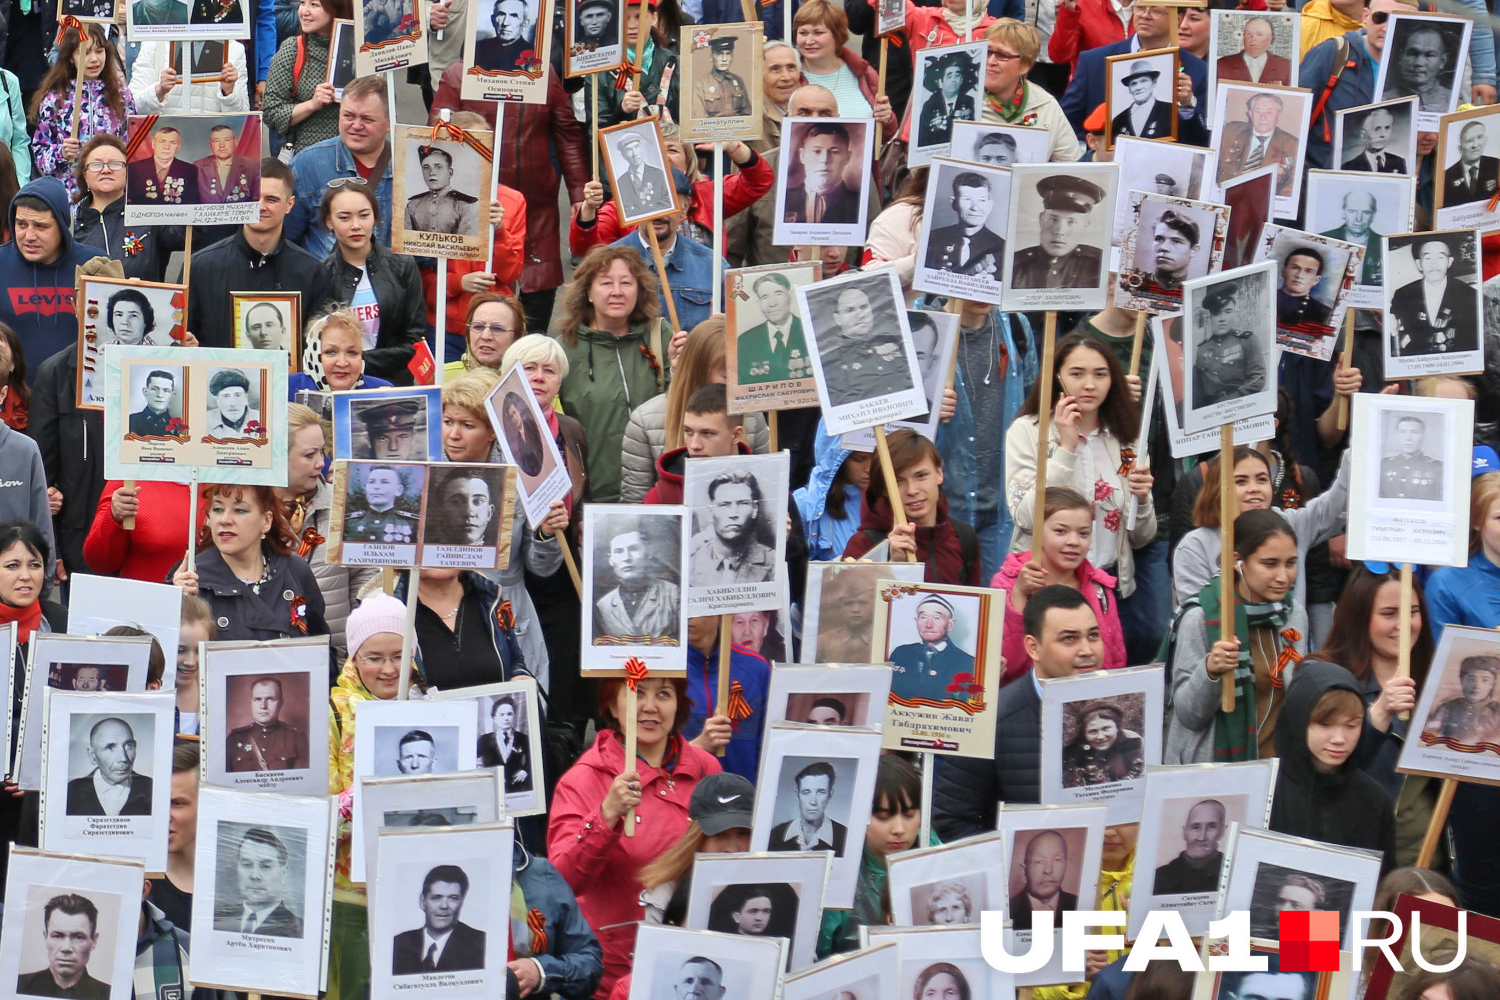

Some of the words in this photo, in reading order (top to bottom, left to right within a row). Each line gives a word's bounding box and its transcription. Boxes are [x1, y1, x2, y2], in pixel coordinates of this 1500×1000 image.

[369, 44, 396, 58] Данилов
[396, 42, 416, 51] Павел
[487, 86, 523, 94] Осипович
[130, 211, 188, 219] ОДНОПОЛЧАНИН
[193, 210, 254, 218] ГАЛИАХМЕТОВИЧ
[1452, 211, 1484, 222] Бабушкин
[418, 232, 464, 244] КУЛЬКОВ
[403, 239, 436, 249] НИКОЛАЙ
[436, 242, 480, 253] ВАСИЛЬЕВИЧ
[748, 381, 802, 393] ШАРИПОВ
[734, 392, 776, 401] ФАХРИСЛАМ
[776, 388, 816, 397] САБУРОВИЧ
[858, 398, 890, 410] БАКАЕВ
[838, 408, 872, 422] МИХАИЛ
[872, 400, 914, 414] ИВАНОВИЧ
[364, 550, 395, 558] ИЛЬХАМ
[706, 586, 758, 596] ХАБИБУЛЛИН
[688, 596, 714, 604] САЛИМ
[890, 708, 939, 720] Аккужин
[941, 712, 976, 724] Жават
[892, 719, 972, 734] Габдрахимович
[234, 777, 268, 785] Александр
[268, 775, 304, 783] Андреевич
[86, 816, 131, 824] Сиразетдинов
[241, 934, 276, 944] Митрохин
[225, 940, 248, 949] Артём
